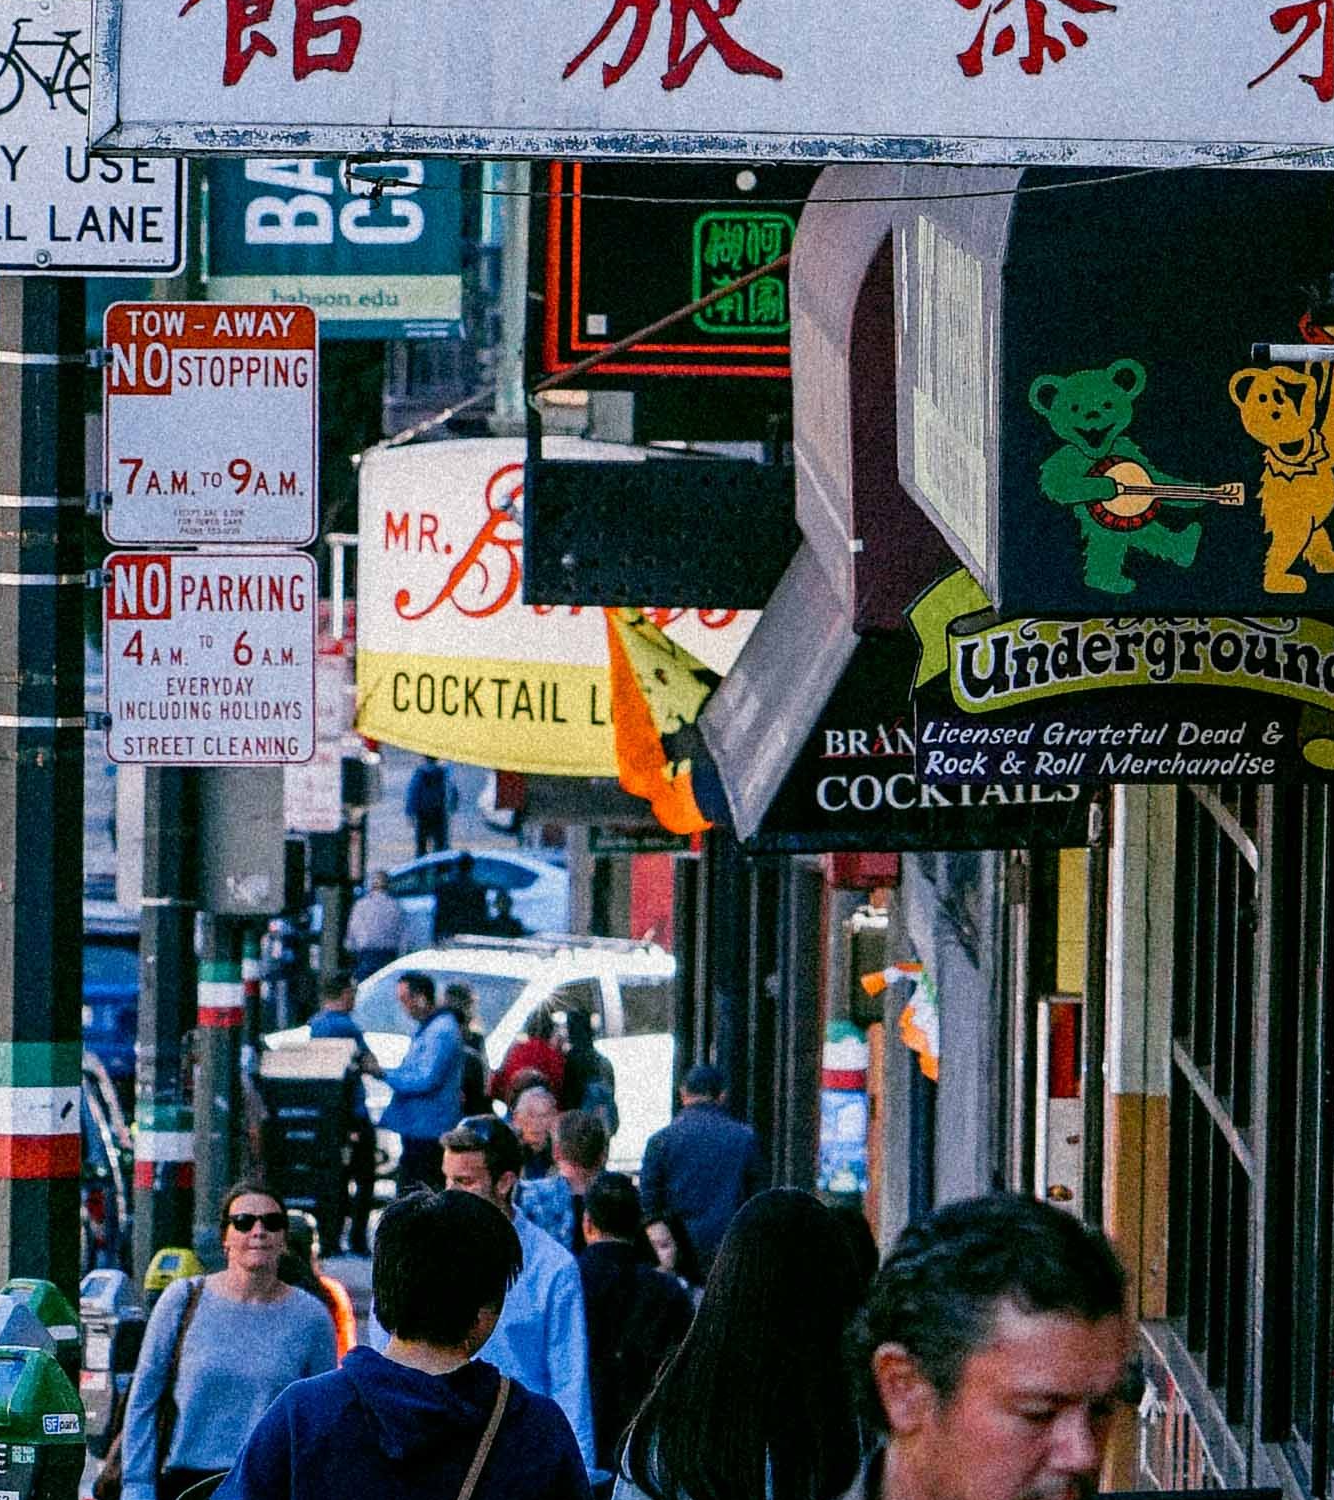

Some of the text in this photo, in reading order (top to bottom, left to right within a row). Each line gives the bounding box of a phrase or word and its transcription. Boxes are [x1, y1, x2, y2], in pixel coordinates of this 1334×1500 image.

[65, 153, 156, 184] USE
[48, 204, 164, 242] LANE
[127, 312, 184, 337] TOW
[213, 312, 295, 338] AWAY
[112, 344, 308, 388] NO STOPPING
[201, 471, 222, 488] TO
[385, 511, 453, 555] MR.
[114, 563, 305, 616] NO PARKING
[199, 635, 214, 649] TO
[167, 677, 254, 696] EVERYDAY
[393, 671, 567, 724] COCKTAIL
[119, 701, 302, 721] INCLUDING HOLIDAYS
[123, 736, 300, 756] STREET CLEANING
[922, 721, 1284, 747] Licensed Grateful Dead &
[925, 748, 1277, 776] Rock & Roll Merchandise
